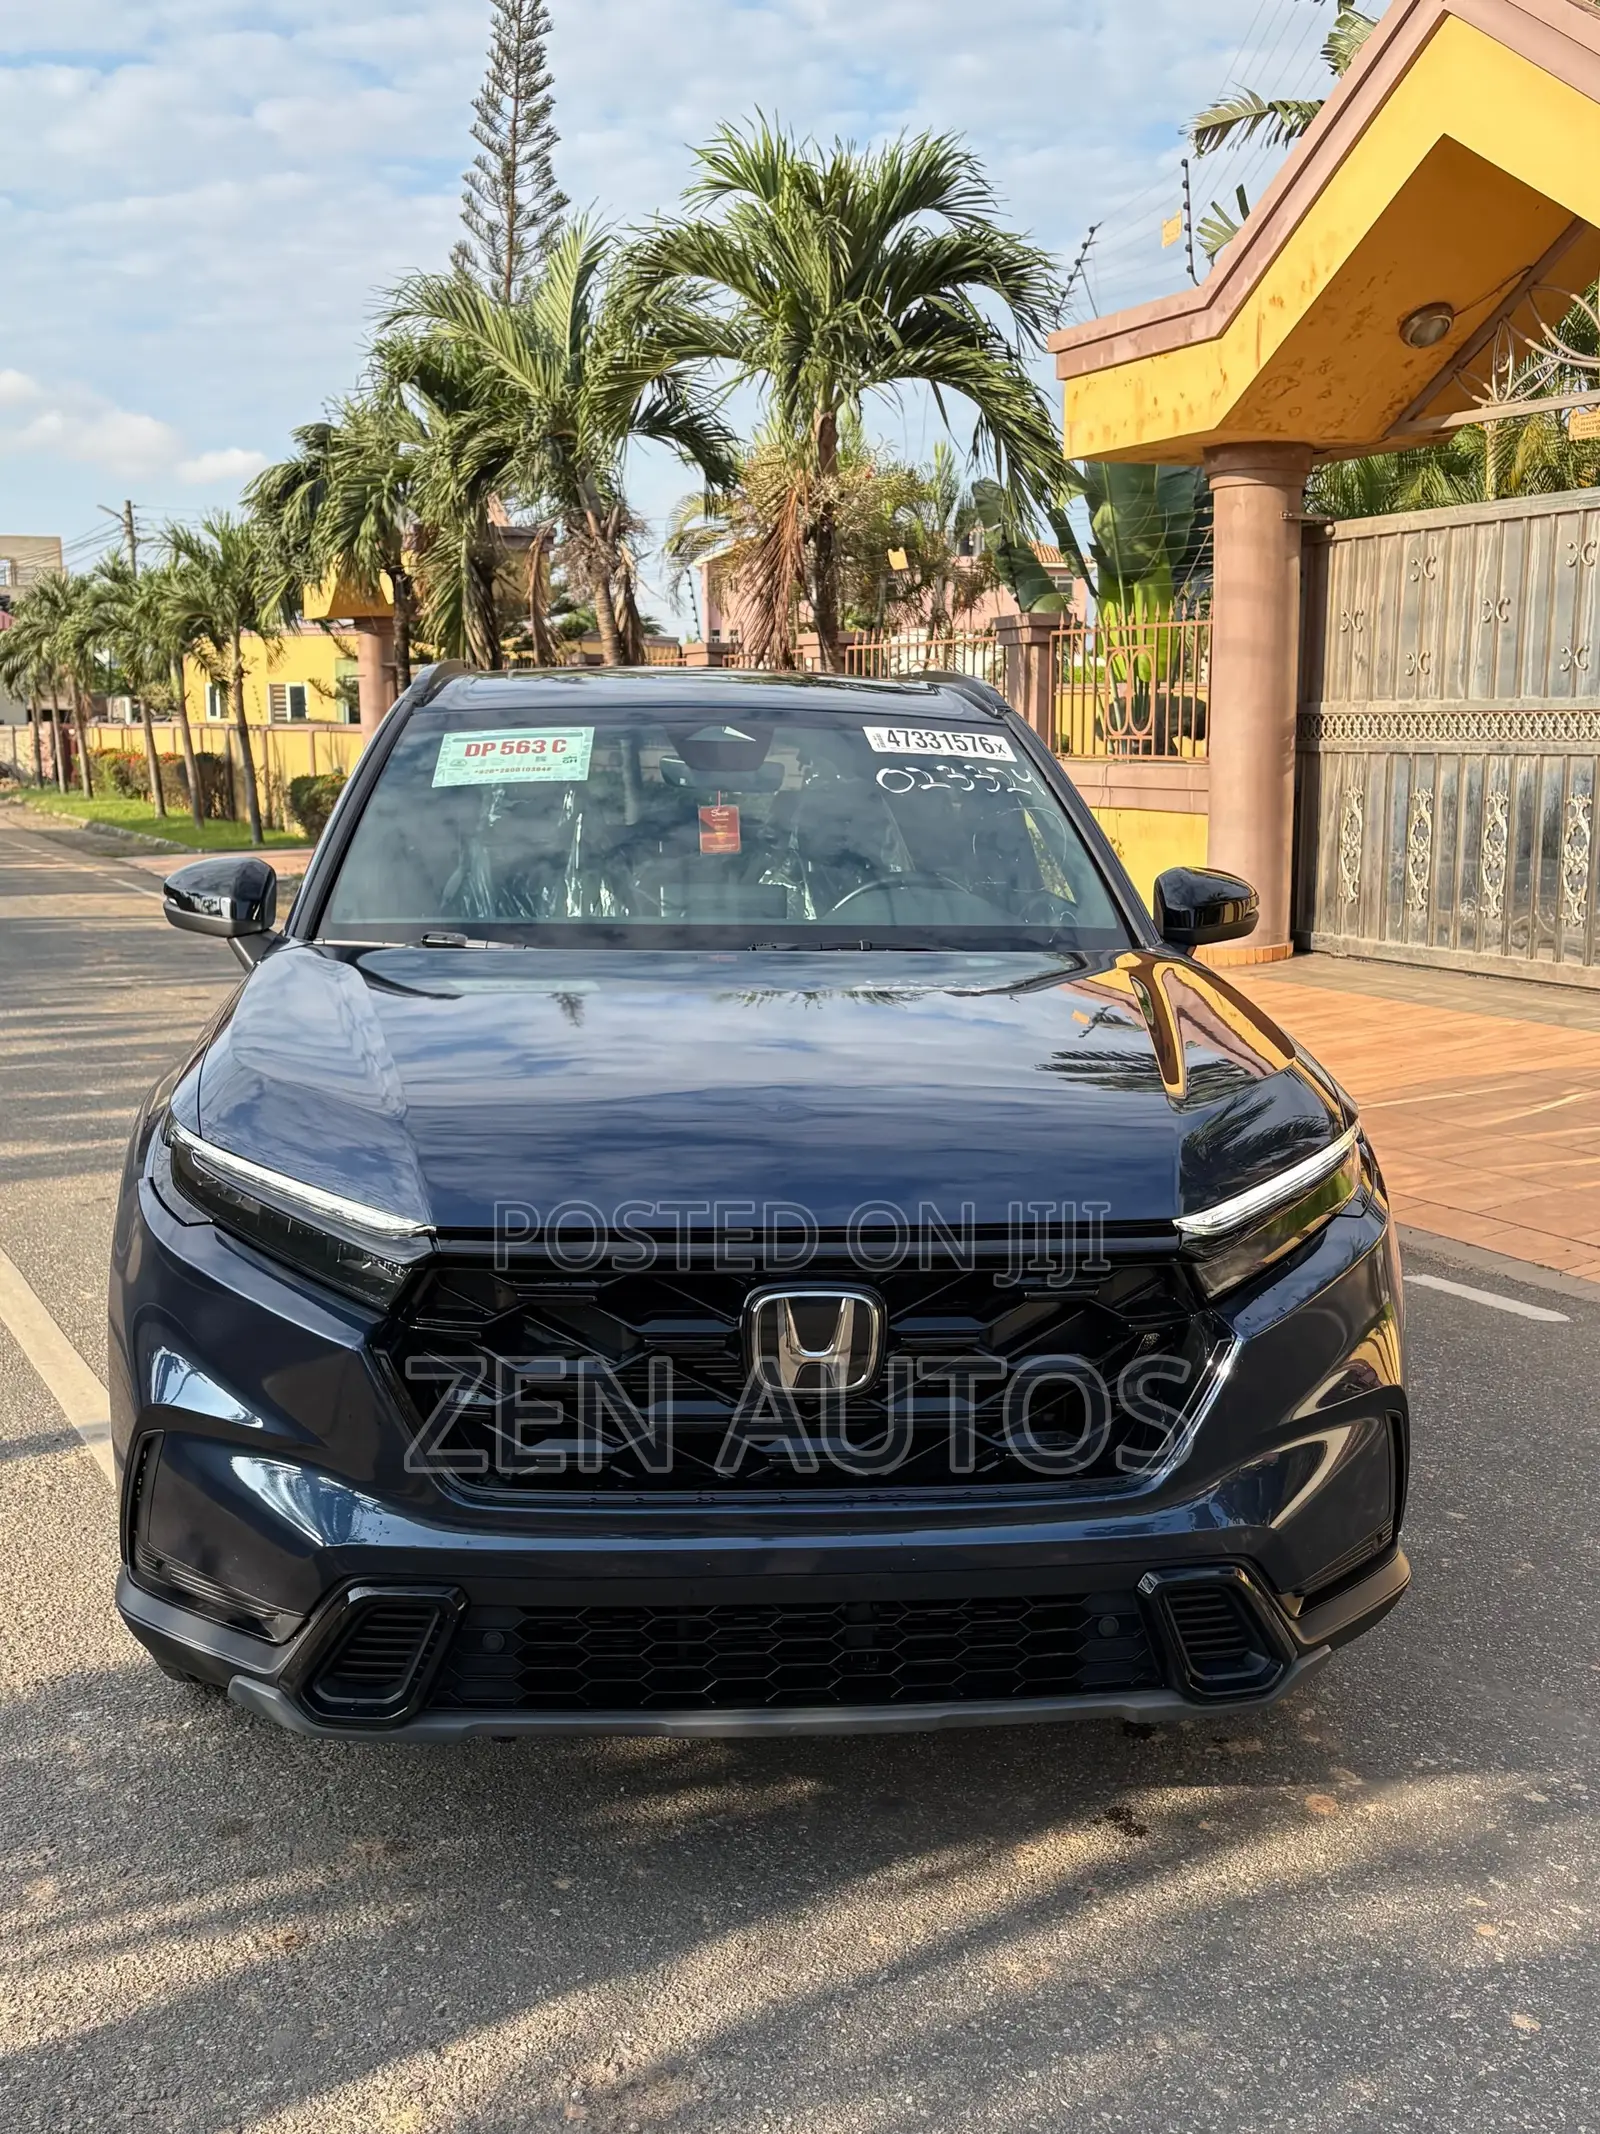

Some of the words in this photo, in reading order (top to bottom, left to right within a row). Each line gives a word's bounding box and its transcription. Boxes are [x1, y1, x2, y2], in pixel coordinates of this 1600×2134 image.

[465, 743, 495, 757] DP
[500, 740, 546, 755] 563
[551, 739, 567, 753] C
